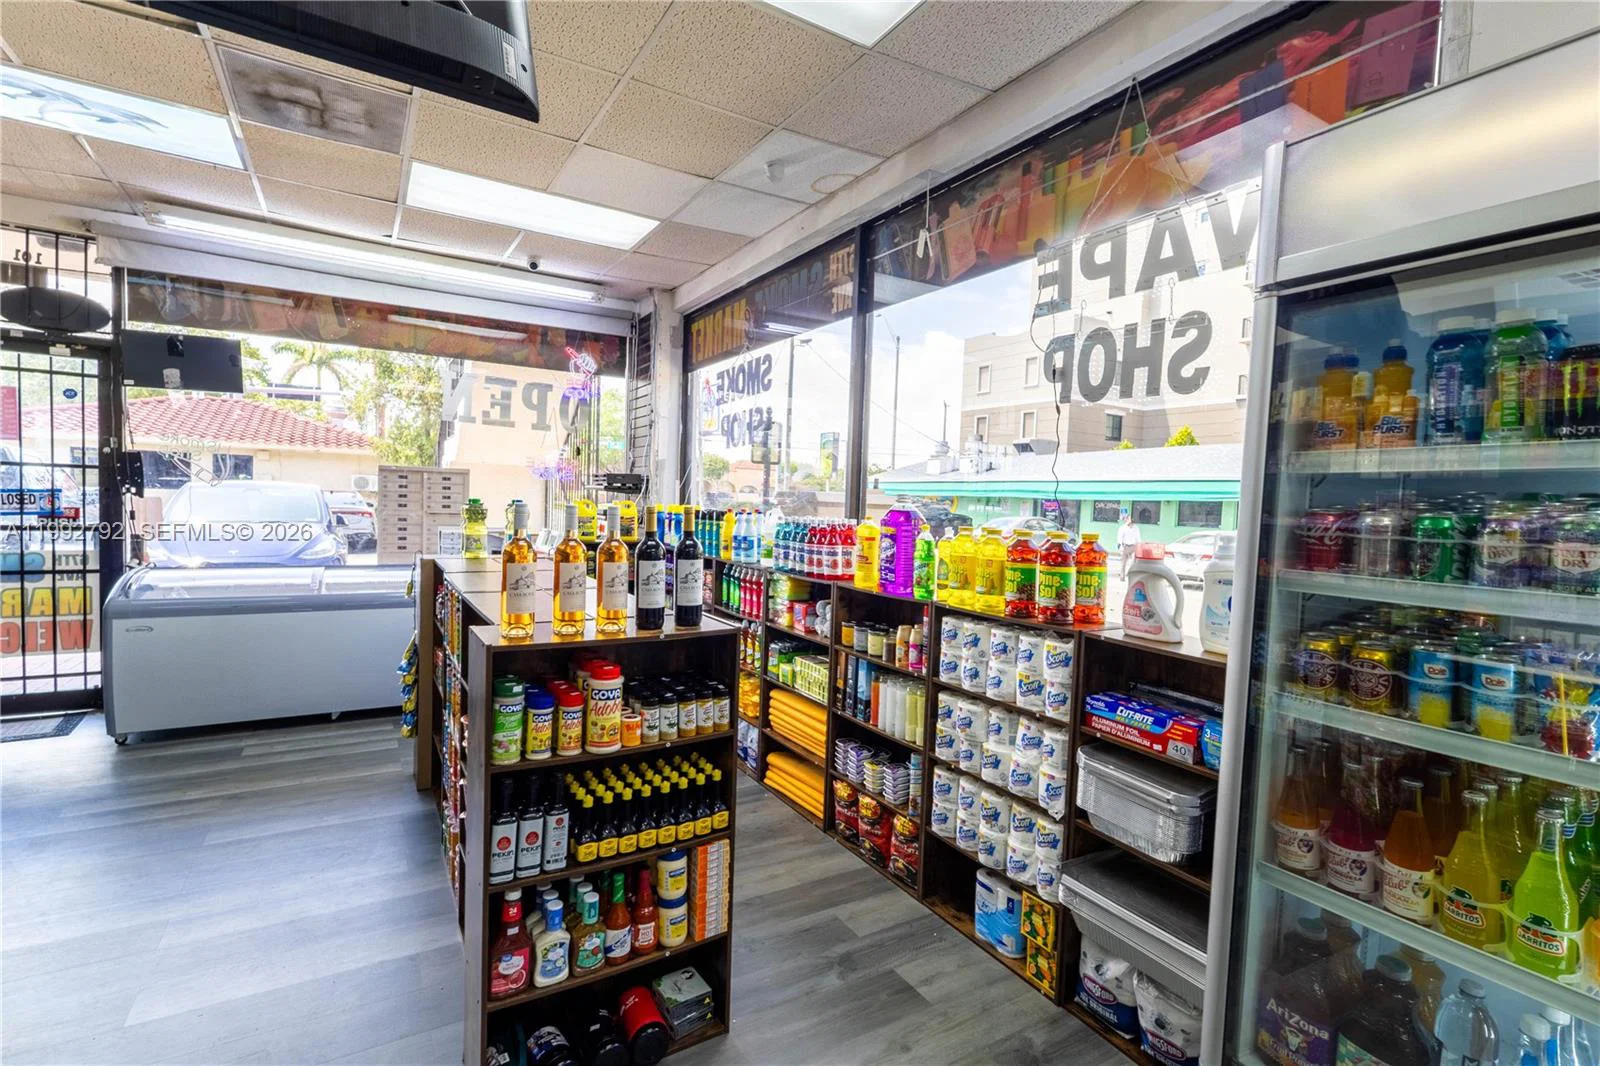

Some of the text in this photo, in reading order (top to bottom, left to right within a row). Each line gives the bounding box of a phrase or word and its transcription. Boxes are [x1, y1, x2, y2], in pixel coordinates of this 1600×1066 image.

[1561, 559, 1589, 568] DRY
[1048, 651, 1068, 663] Scott
[1021, 681, 1041, 692] Scott
[1485, 678, 1506, 688] Dole
[1116, 706, 1155, 725] CUT-RITE
[1172, 745, 1187, 756] 40
[1518, 930, 1560, 952] JARRITOS
[1266, 998, 1329, 1040] AriZona
